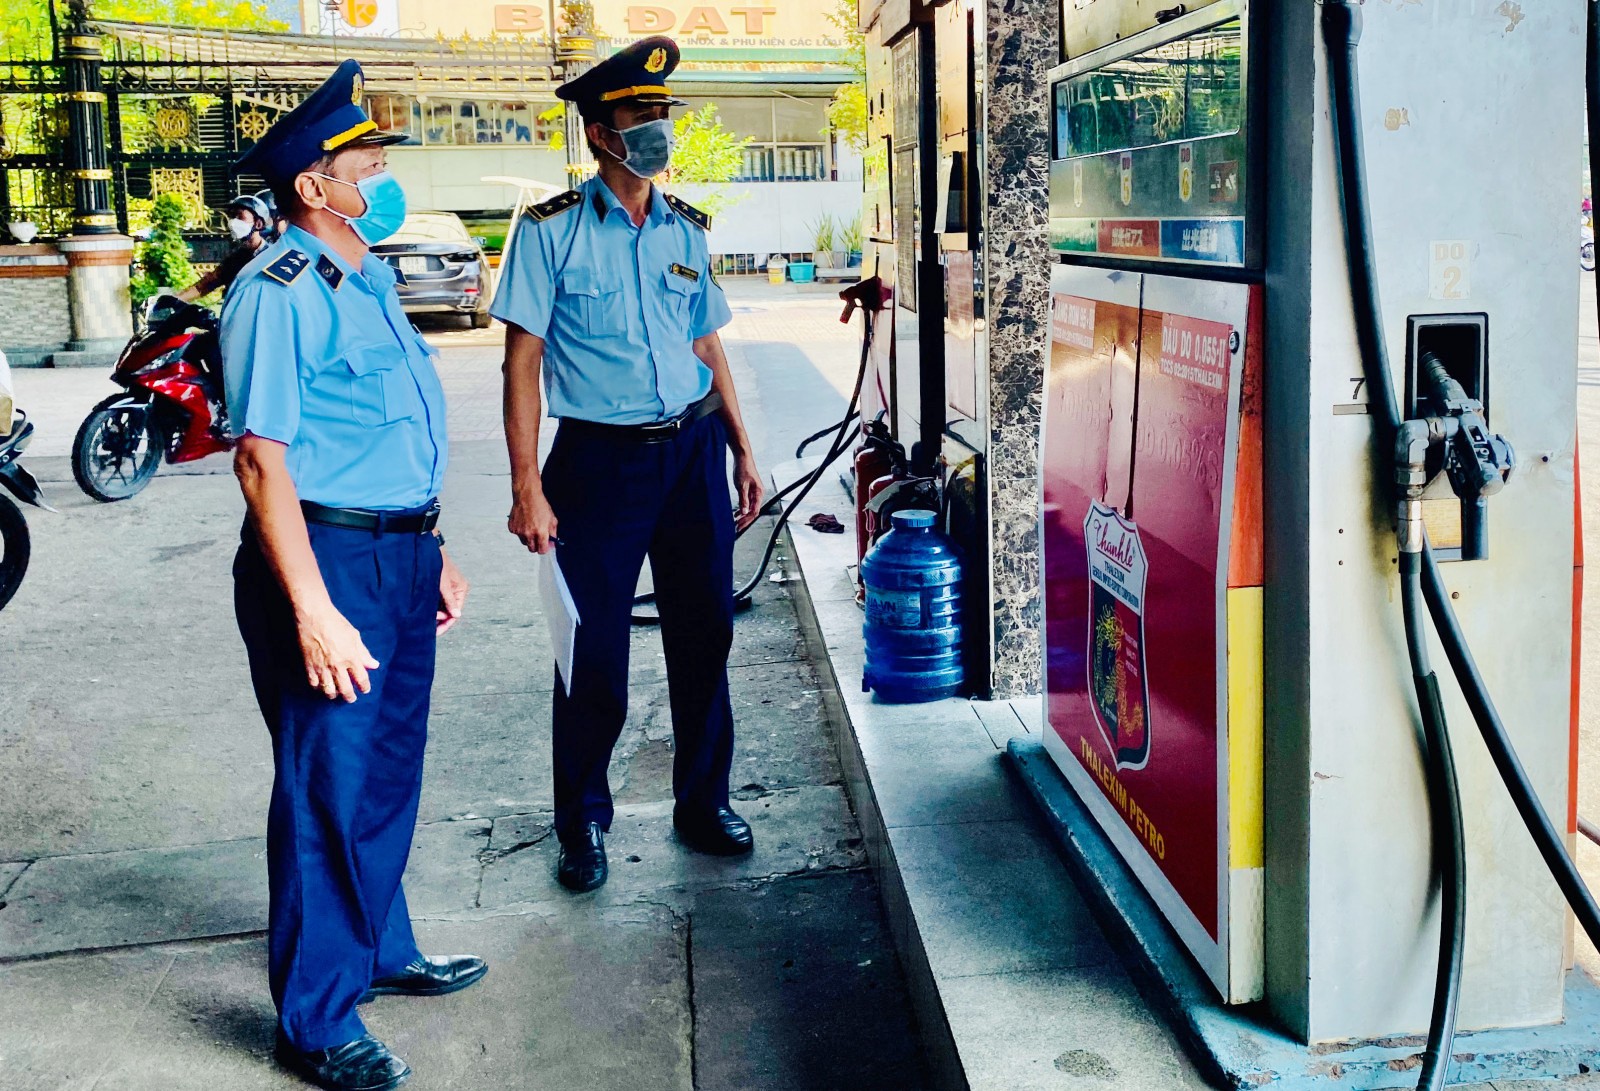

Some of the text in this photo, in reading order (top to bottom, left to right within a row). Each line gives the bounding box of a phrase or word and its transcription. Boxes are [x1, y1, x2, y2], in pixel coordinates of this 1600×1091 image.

[1435, 243, 1465, 261] DO
[1443, 266, 1462, 299] 2
[1180, 330, 1192, 360] DO
[1350, 377, 1366, 400] 7
[1080, 735, 1165, 860] THALEXIM PETRO
